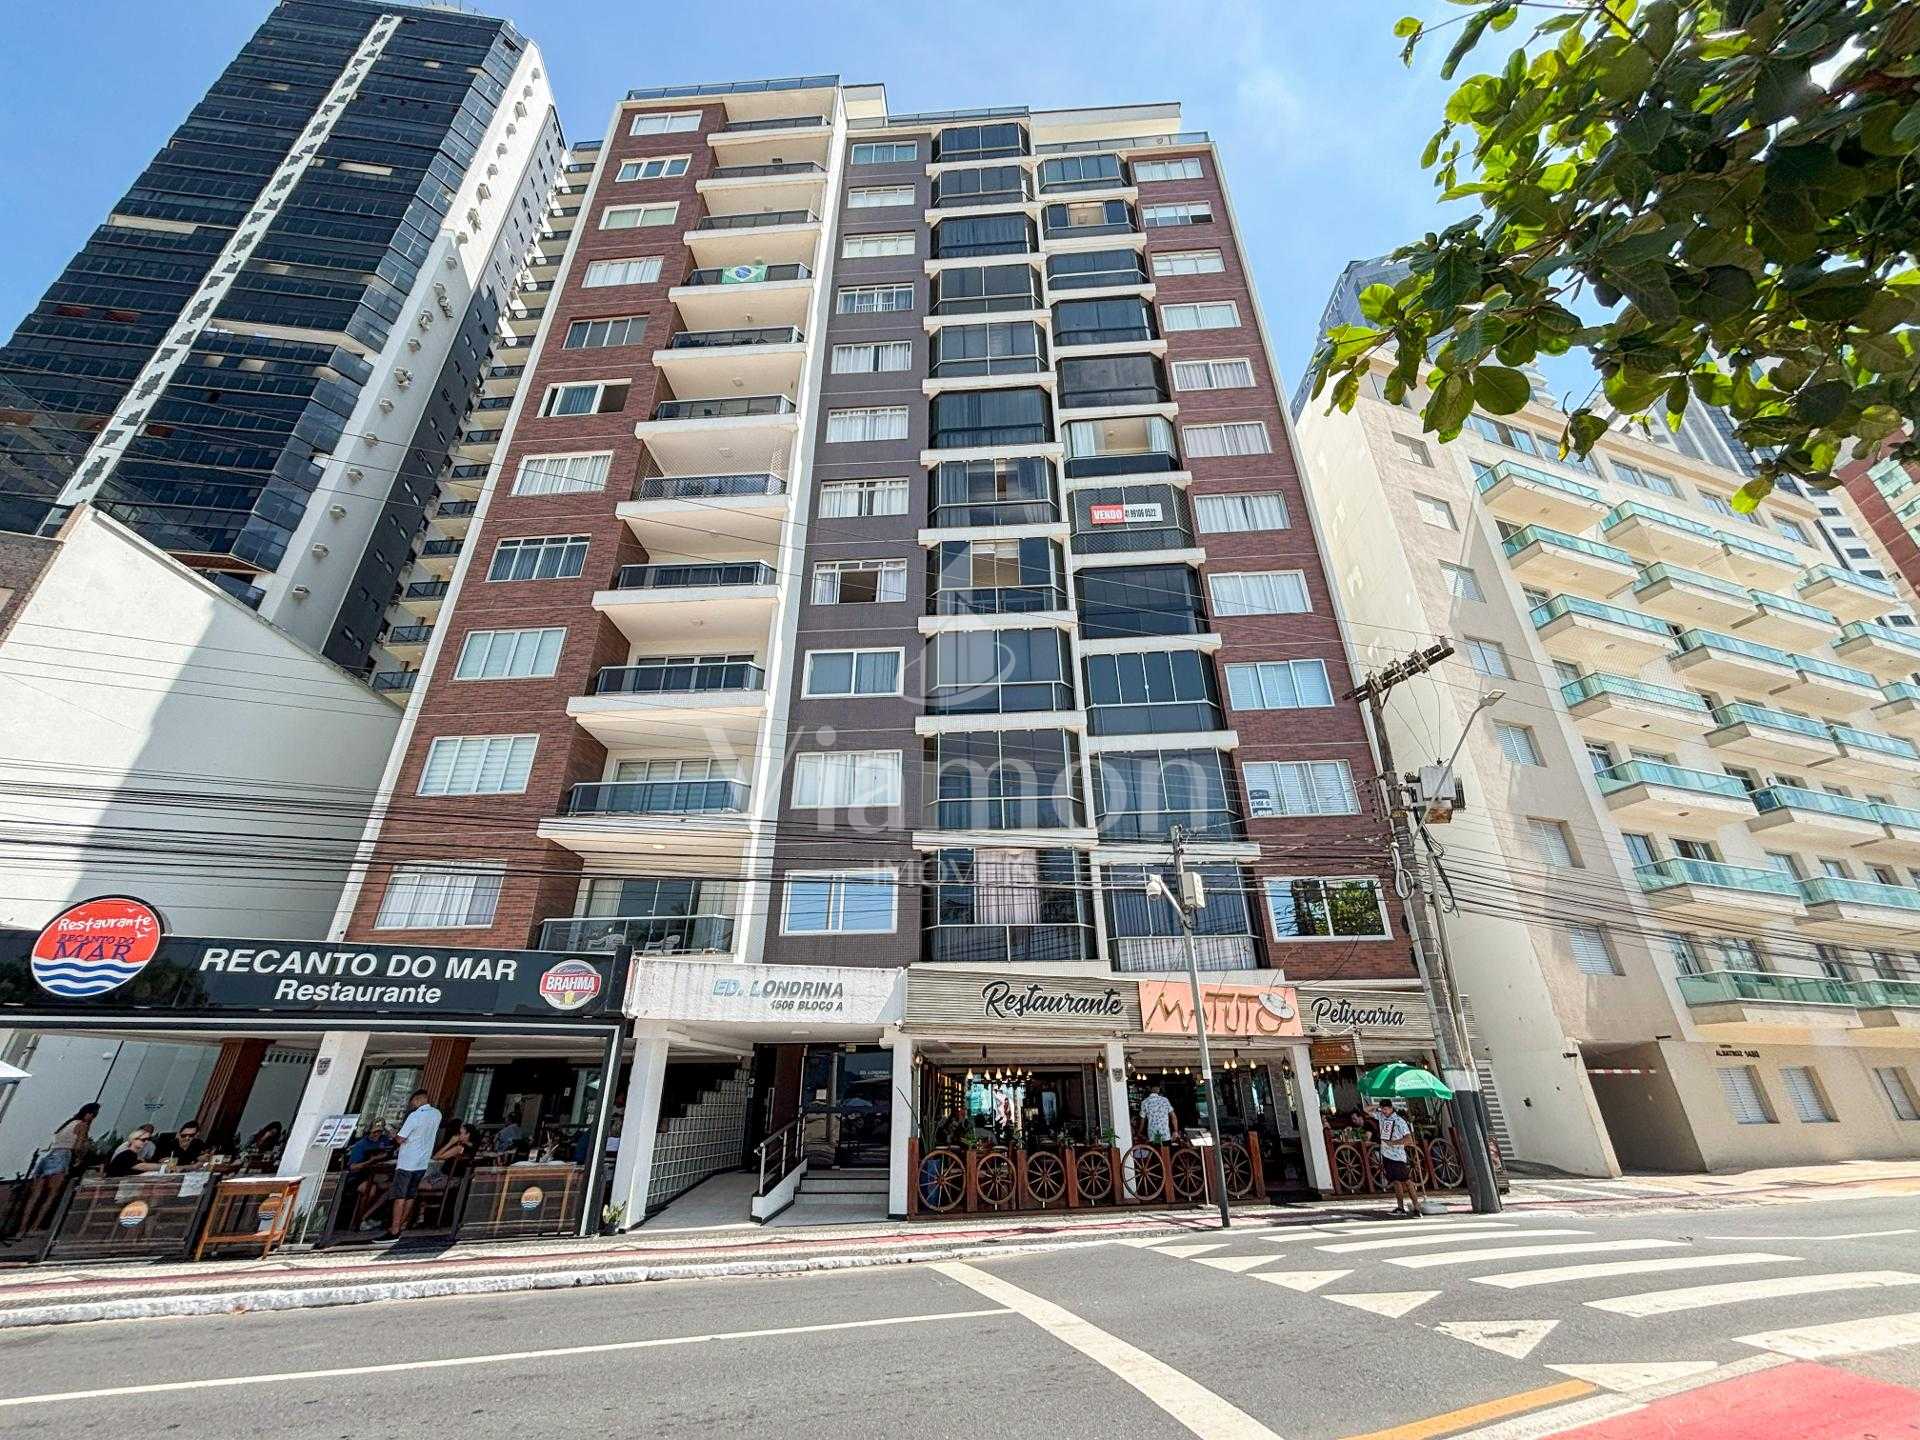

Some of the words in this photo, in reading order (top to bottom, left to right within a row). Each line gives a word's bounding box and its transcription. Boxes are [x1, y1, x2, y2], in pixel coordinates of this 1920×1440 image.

[1092, 509, 1122, 520] VENDO
[58, 915, 151, 931] Restaurante
[52, 941, 132, 962] MAR
[199, 948, 377, 976] RECANTO
[386, 954, 436, 978] DO
[444, 957, 517, 981] MAR
[274, 979, 441, 1004] Restaurante
[546, 976, 595, 991] BRAHMA
[749, 980, 844, 999] LONDRINA
[797, 1001, 833, 1011] BLOCO
[835, 1001, 843, 1011] A
[982, 981, 1123, 1018] Restaurante
[1144, 991, 1285, 1033] MATUTO
[1311, 997, 1405, 1025] Petiscaria
